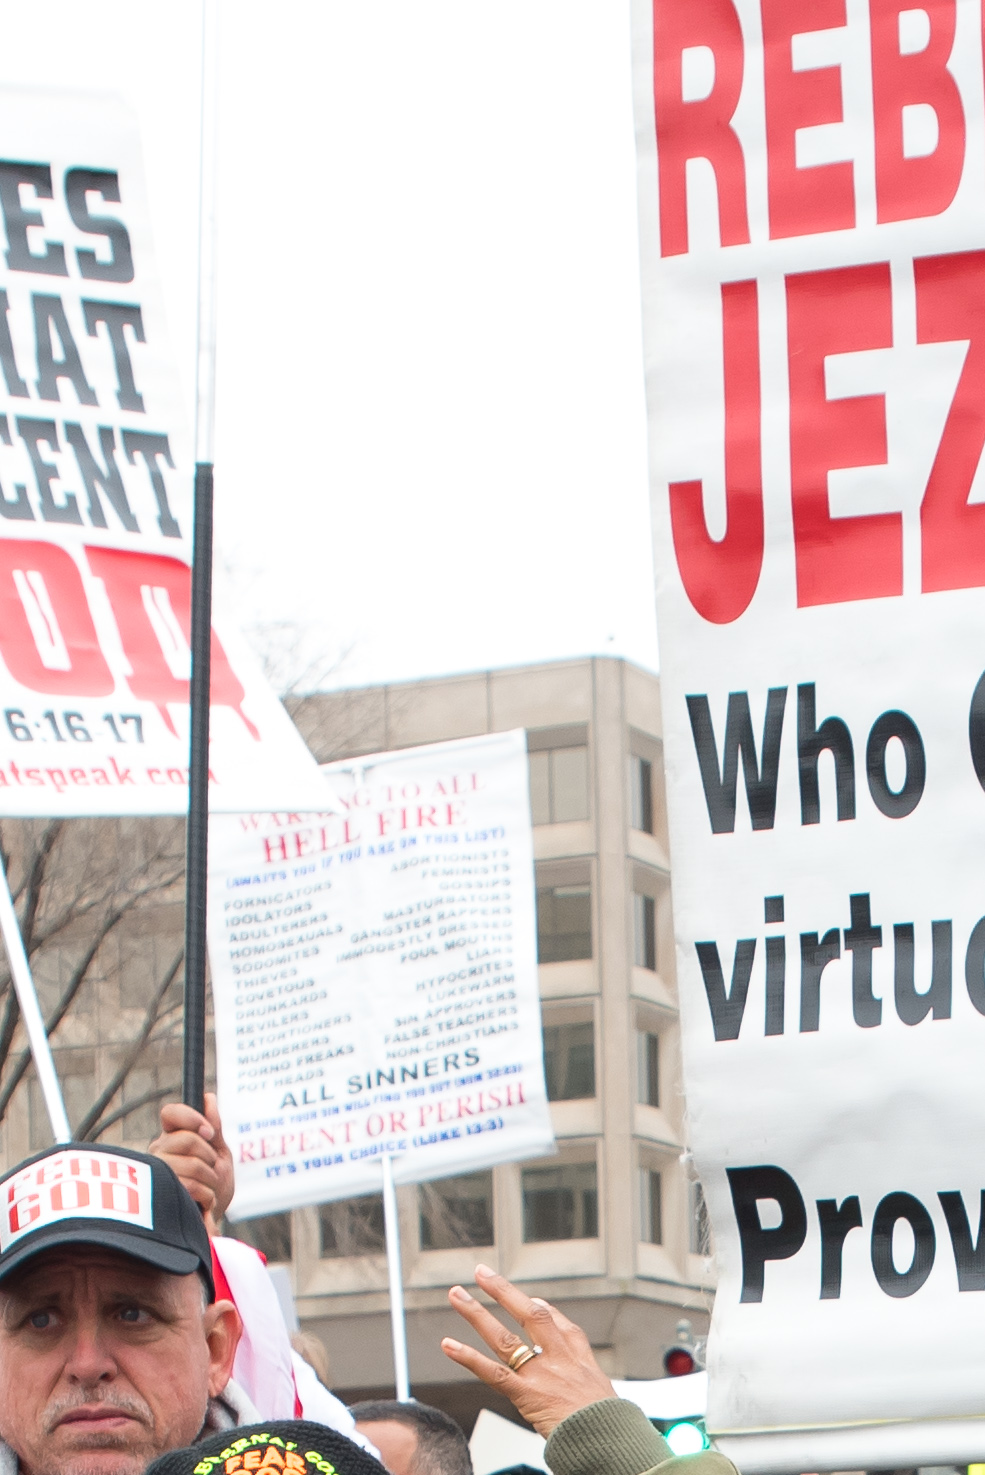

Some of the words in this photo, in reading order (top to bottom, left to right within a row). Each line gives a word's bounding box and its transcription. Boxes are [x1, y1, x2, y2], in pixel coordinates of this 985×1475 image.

[653, 0, 985, 259] REB
[685, 681, 926, 835] Who
[432, 773, 485, 797] ALL
[263, 818, 360, 862] HELL
[377, 801, 466, 836] FIRE
[422, 863, 510, 879] FEMINISTS
[232, 946, 321, 976] SODOMITES
[415, 960, 514, 991] HYPOCRITES
[235, 967, 299, 990] THIEVES
[235, 976, 316, 1007] COVETOUS
[235, 990, 329, 1021] DRUNKARDS
[435, 1005, 519, 1033] TEACHERS
[237, 1059, 292, 1080] PORNO
[296, 1043, 356, 1067] FREAKS
[280, 1084, 336, 1111] ALL
[346, 1046, 480, 1096] SINNERS
[237, 1118, 357, 1165] REPENT
[366, 1111, 408, 1138] OR
[418, 1082, 527, 1128] PERISH
[7, 1157, 138, 1204] FEAR
[7, 1179, 140, 1235] GOD
[224, 1444, 308, 1475] FEAR
